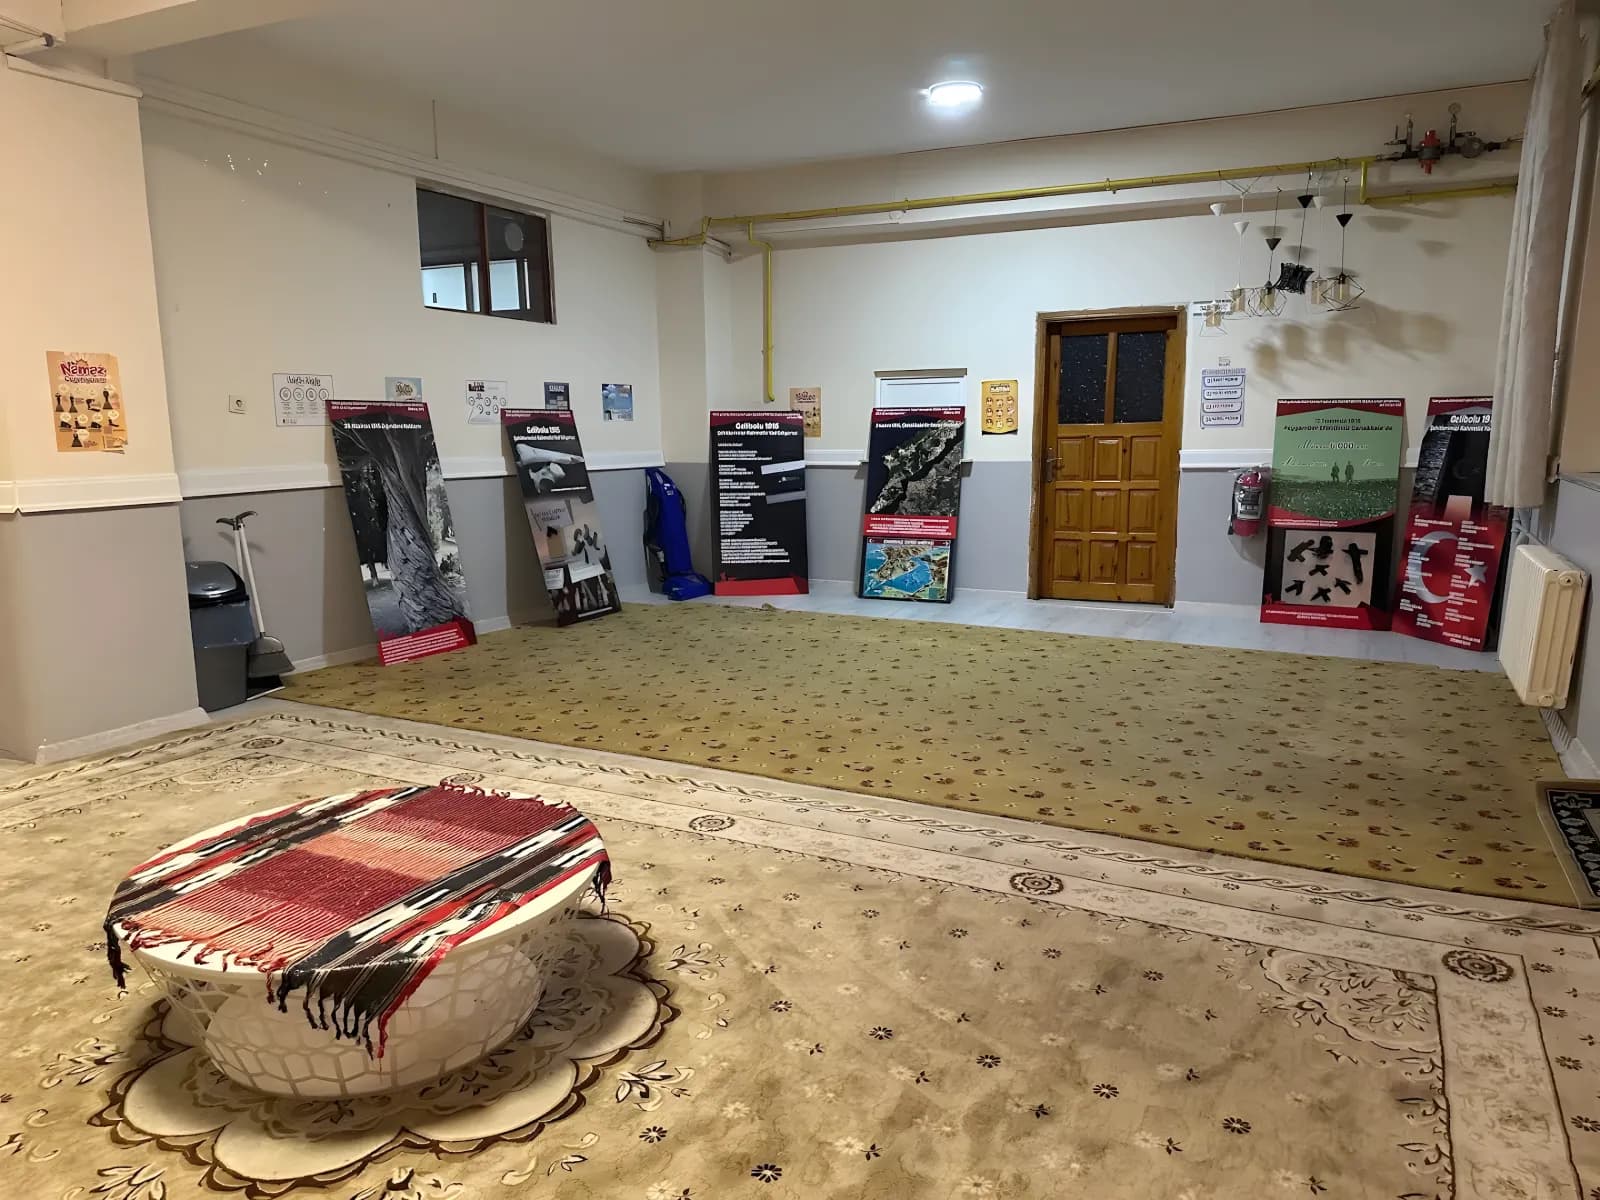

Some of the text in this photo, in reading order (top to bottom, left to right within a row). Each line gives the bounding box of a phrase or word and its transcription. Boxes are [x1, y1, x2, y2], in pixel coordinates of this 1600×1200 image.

[1450, 415, 1491, 424] Gelibolu 19
[526, 425, 549, 434] Gelibolu
[735, 422, 780, 430] Gelibolu 1915
